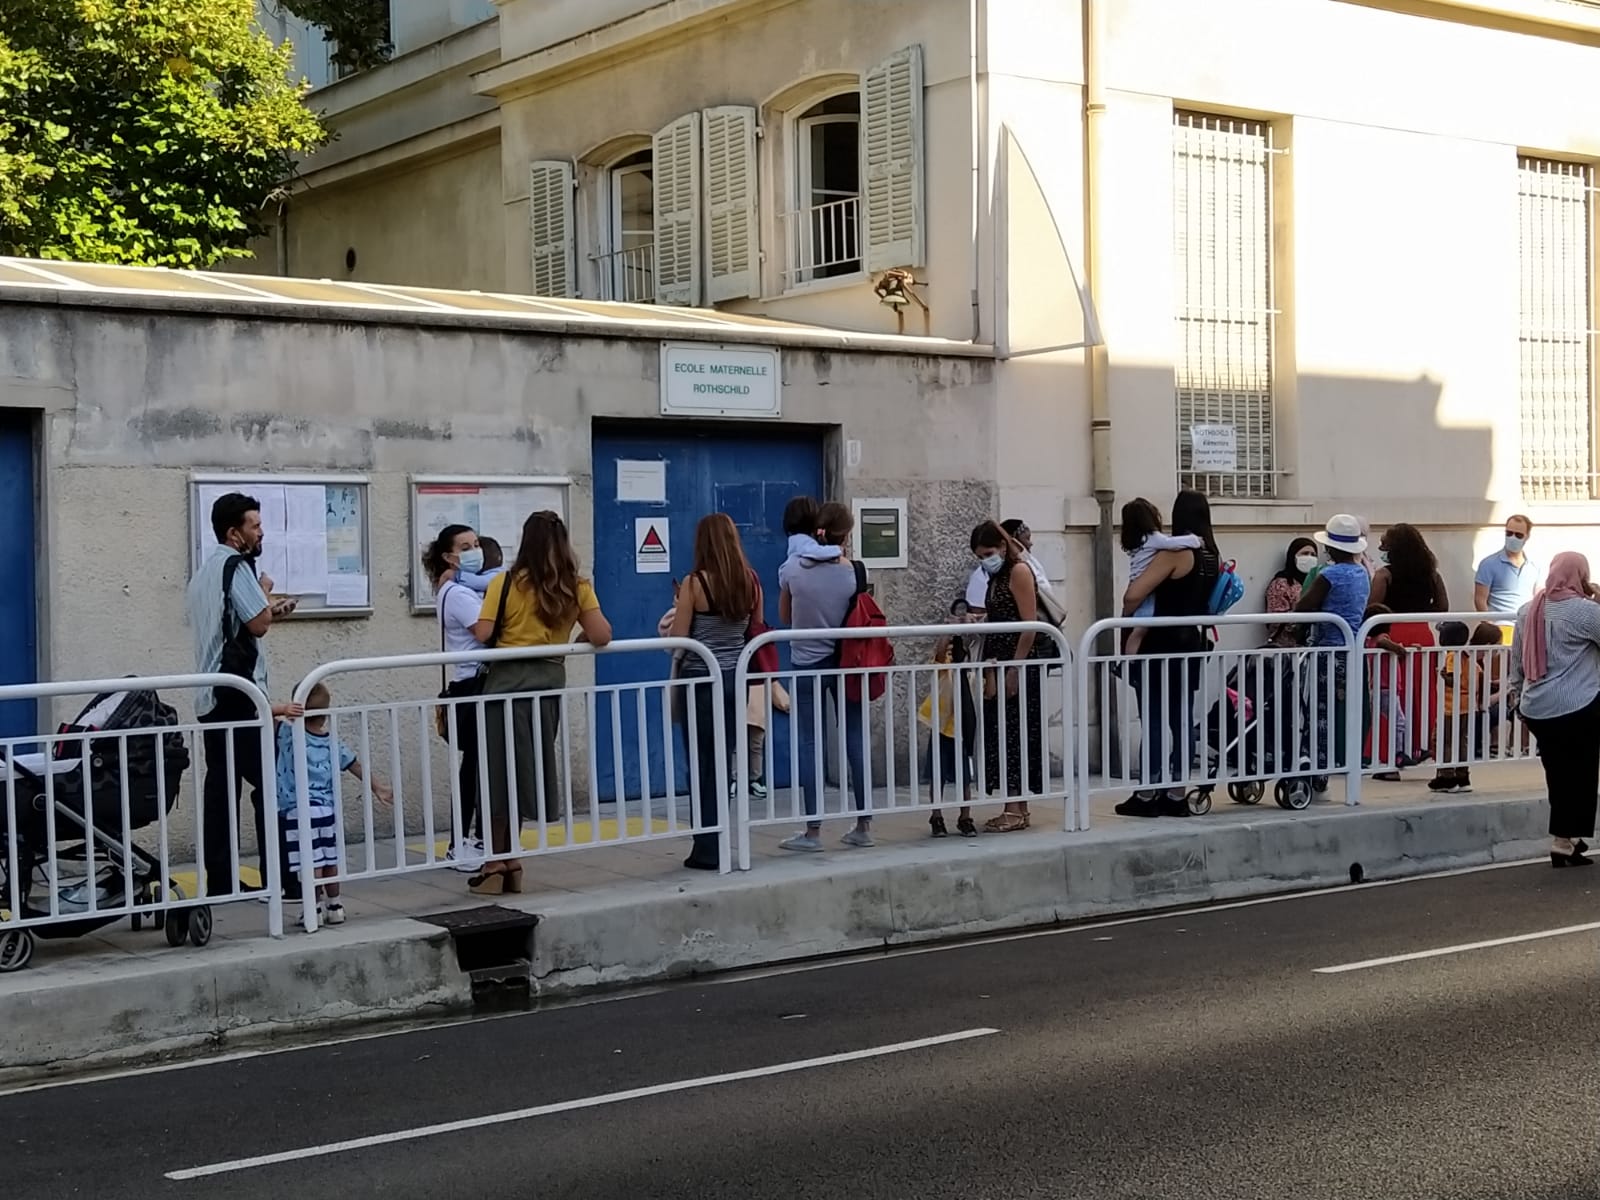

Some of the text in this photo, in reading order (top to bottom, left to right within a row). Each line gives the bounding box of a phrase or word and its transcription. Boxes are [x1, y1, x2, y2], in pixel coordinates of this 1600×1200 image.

[674, 363, 768, 376] ECOLE MATERNELLE
[693, 384, 750, 395] ROTHSCHILD
